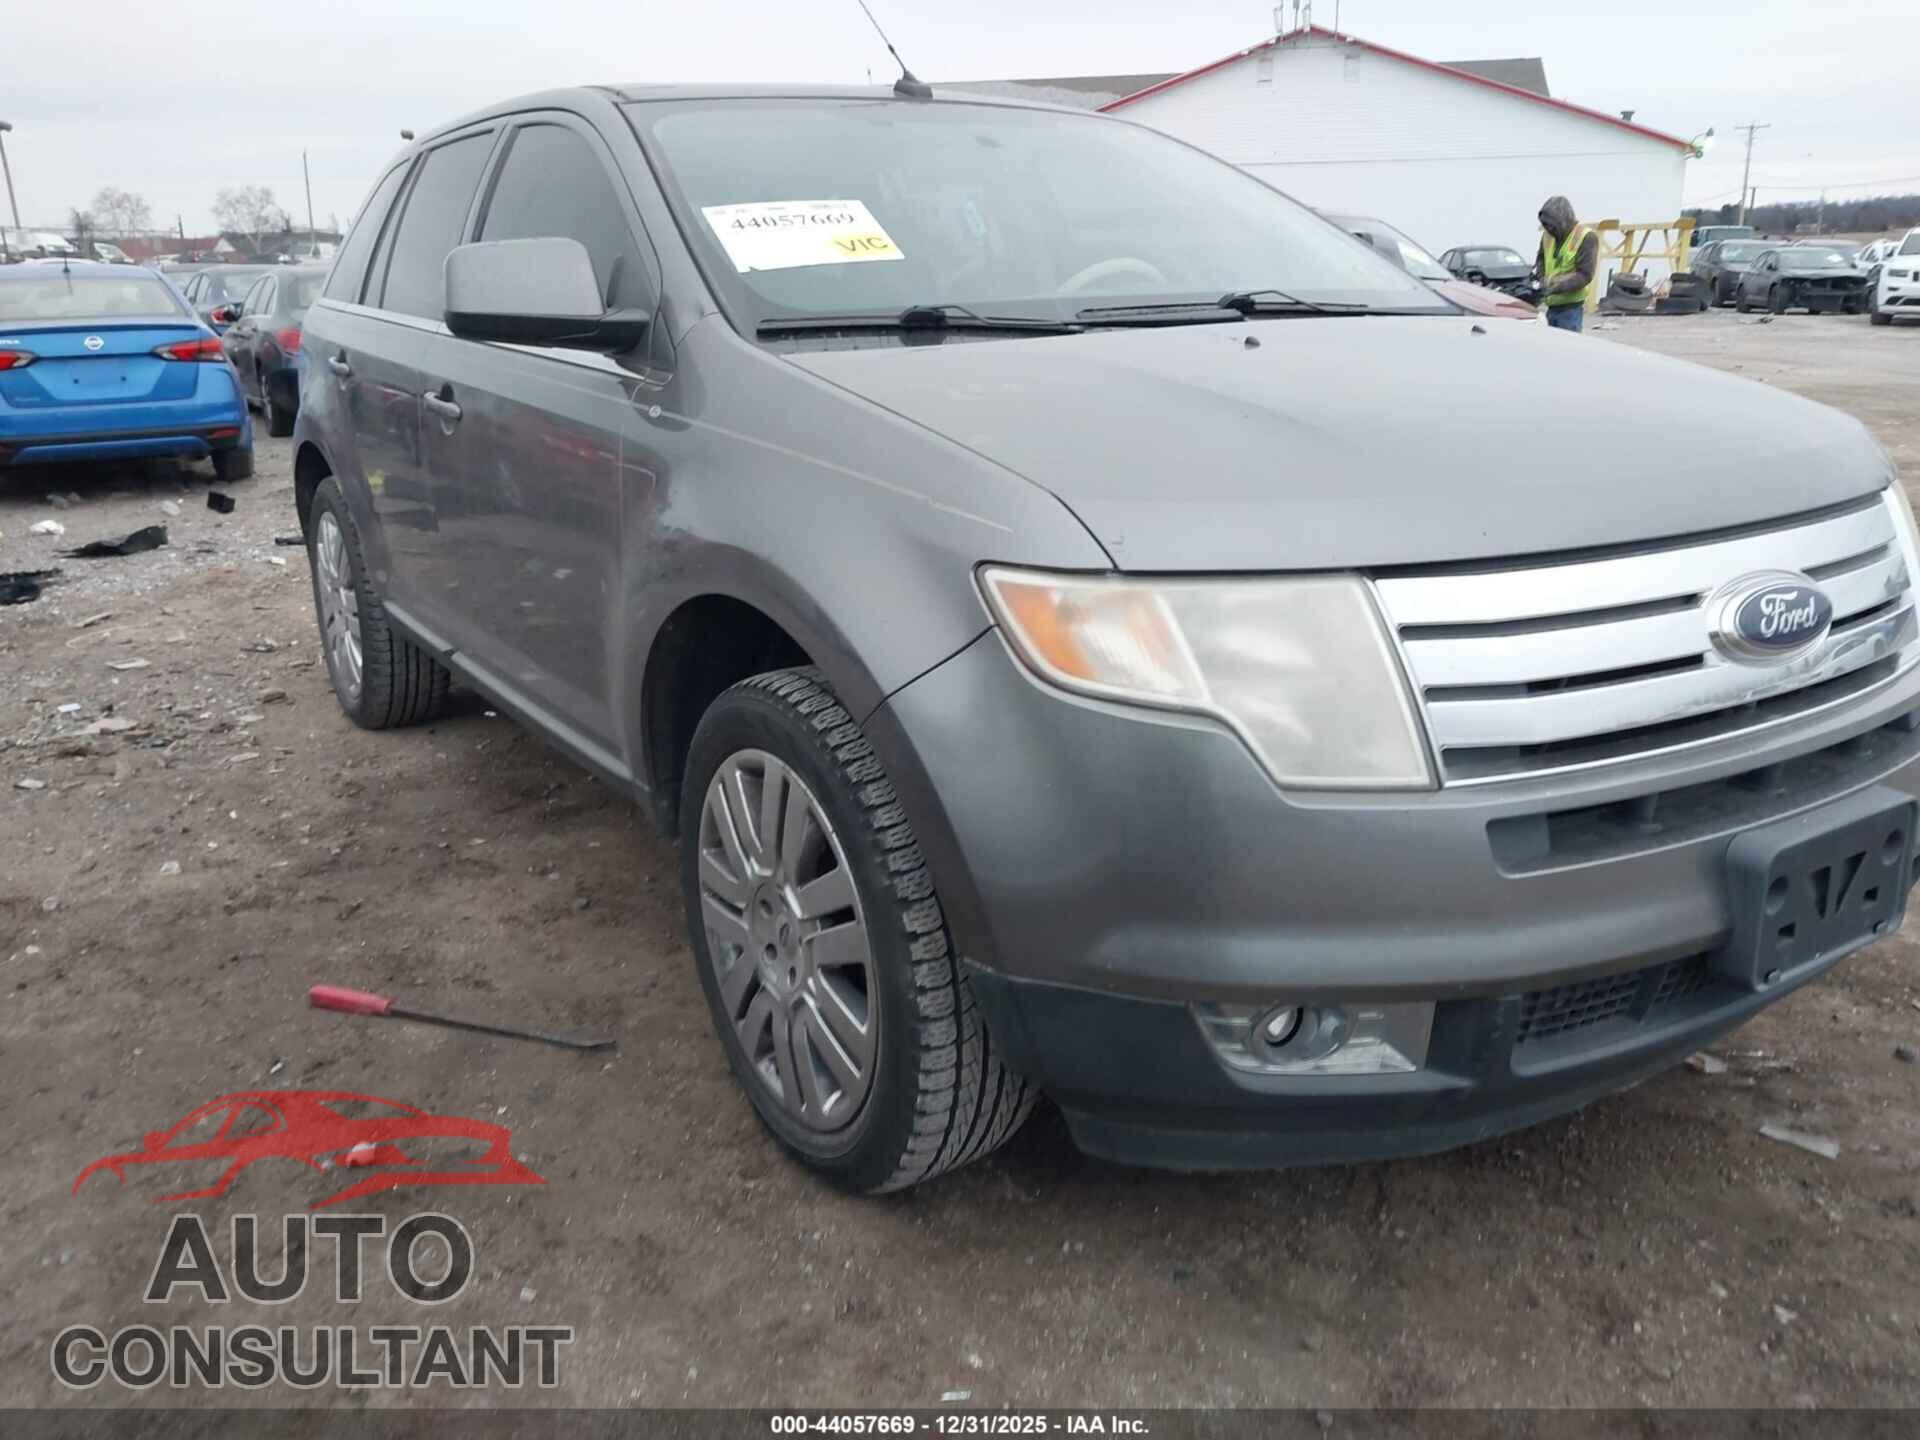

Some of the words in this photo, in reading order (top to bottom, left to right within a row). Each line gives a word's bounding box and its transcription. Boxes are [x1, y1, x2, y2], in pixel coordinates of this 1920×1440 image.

[731, 212, 855, 230] 44057669
[835, 236, 889, 252] VIC
[1760, 591, 1818, 638] Ford
